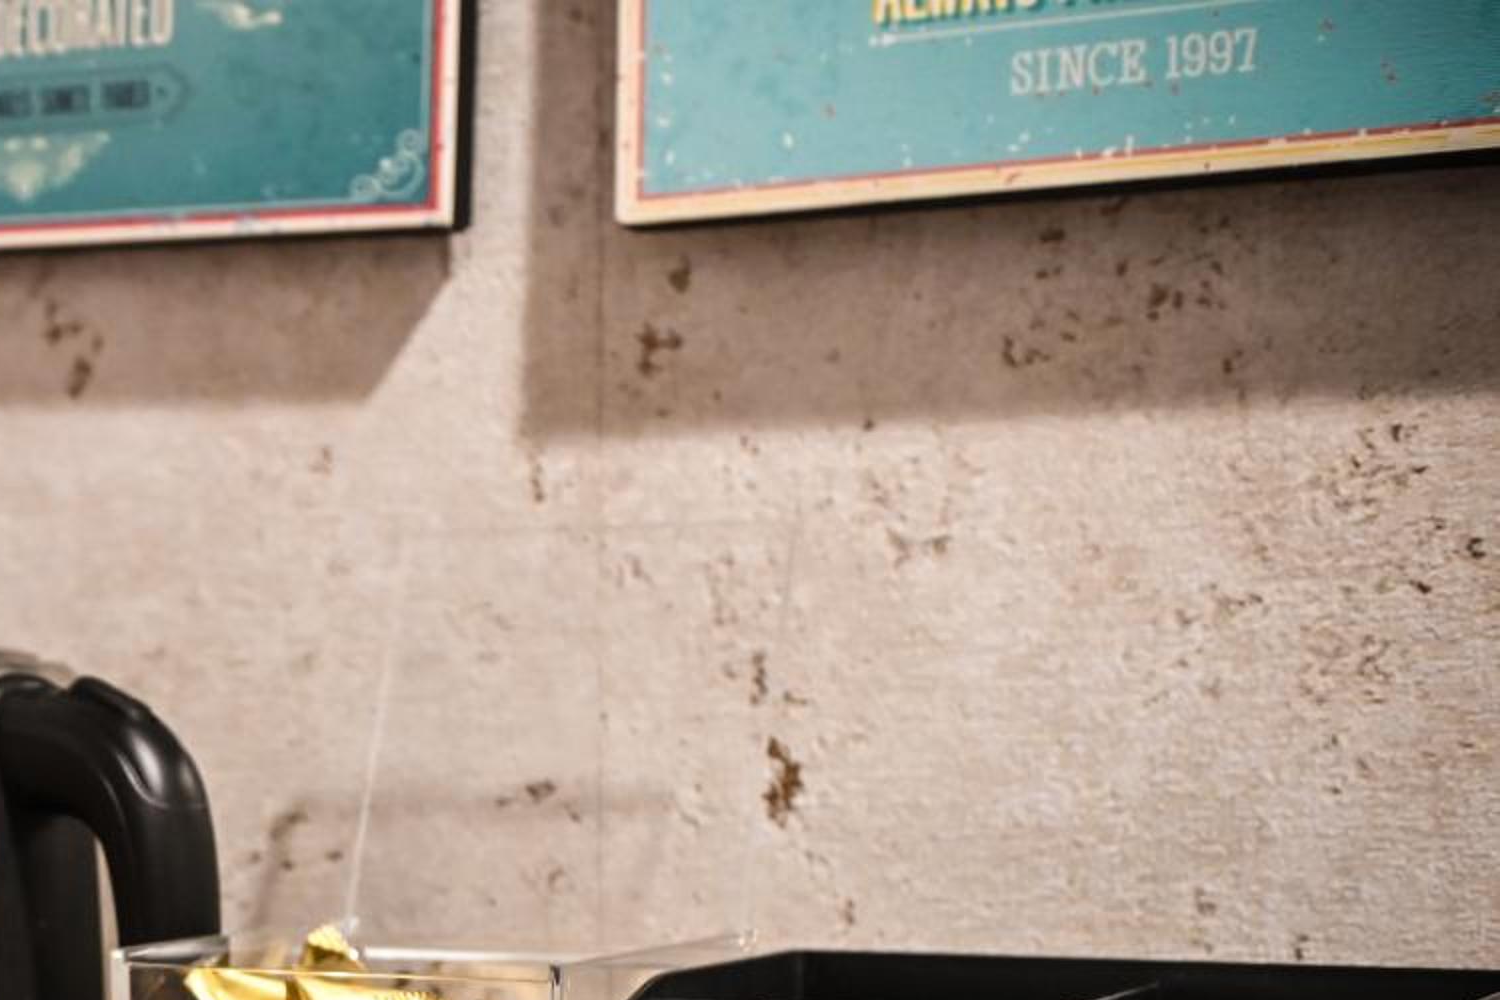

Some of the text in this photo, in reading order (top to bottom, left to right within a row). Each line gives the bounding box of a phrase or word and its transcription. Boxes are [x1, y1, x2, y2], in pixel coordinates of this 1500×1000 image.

[873, 0, 1040, 25] ALWA
[1009, 28, 1259, 96] SINCE 1997
